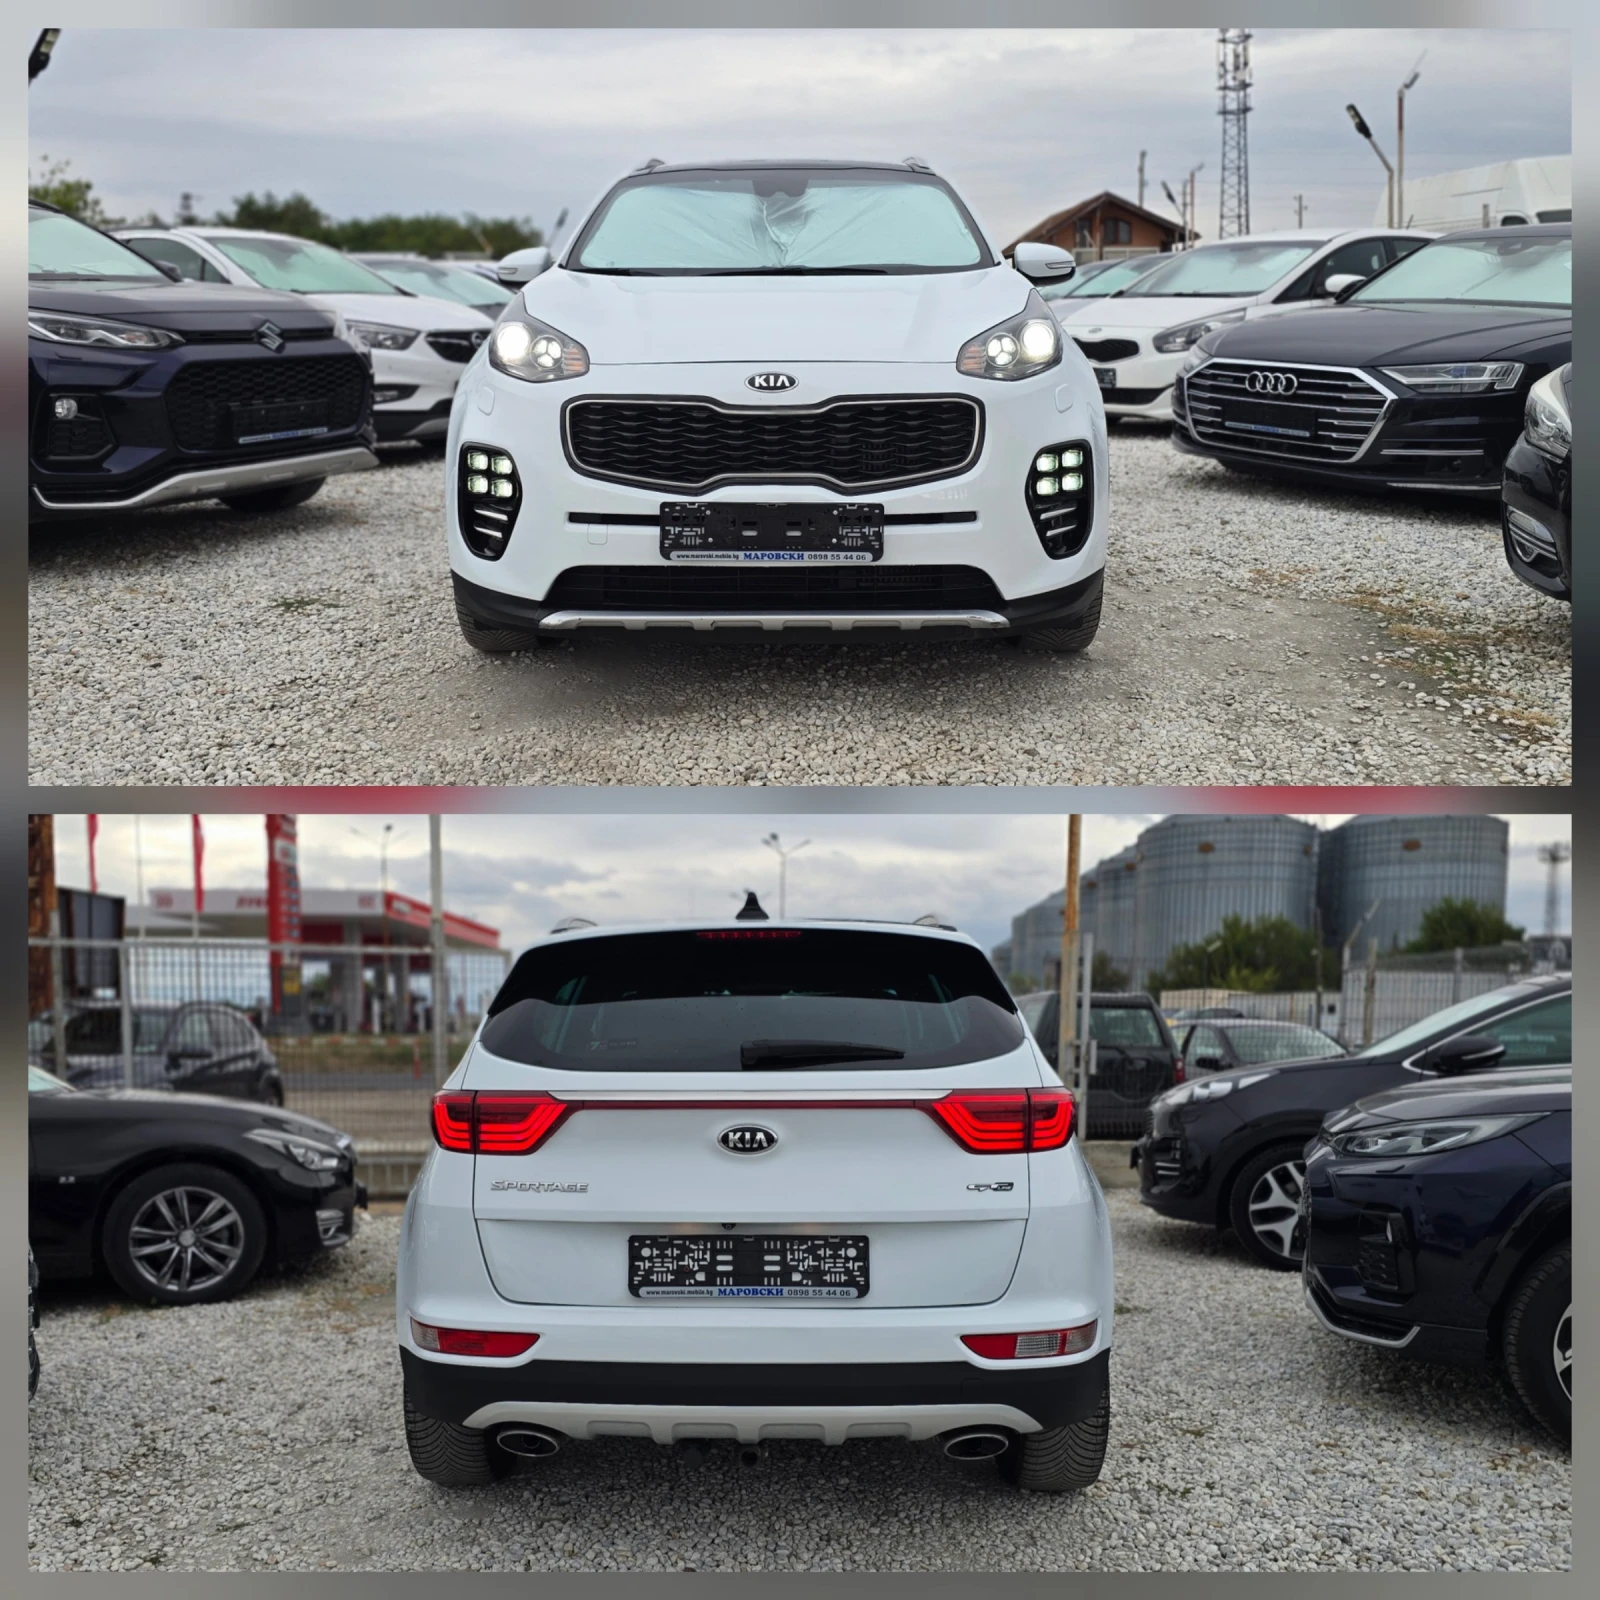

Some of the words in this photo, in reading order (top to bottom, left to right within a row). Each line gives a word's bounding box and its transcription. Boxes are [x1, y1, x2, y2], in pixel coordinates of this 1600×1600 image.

[755, 375, 790, 387] KIA
[676, 553, 739, 561] www.marovski.mobile.bg
[743, 552, 805, 561] МАРОВСКИ
[728, 1132, 768, 1148] KIA
[490, 1179, 589, 1193] SPORTAGE
[717, 1287, 785, 1297] МАРОВСКИ
